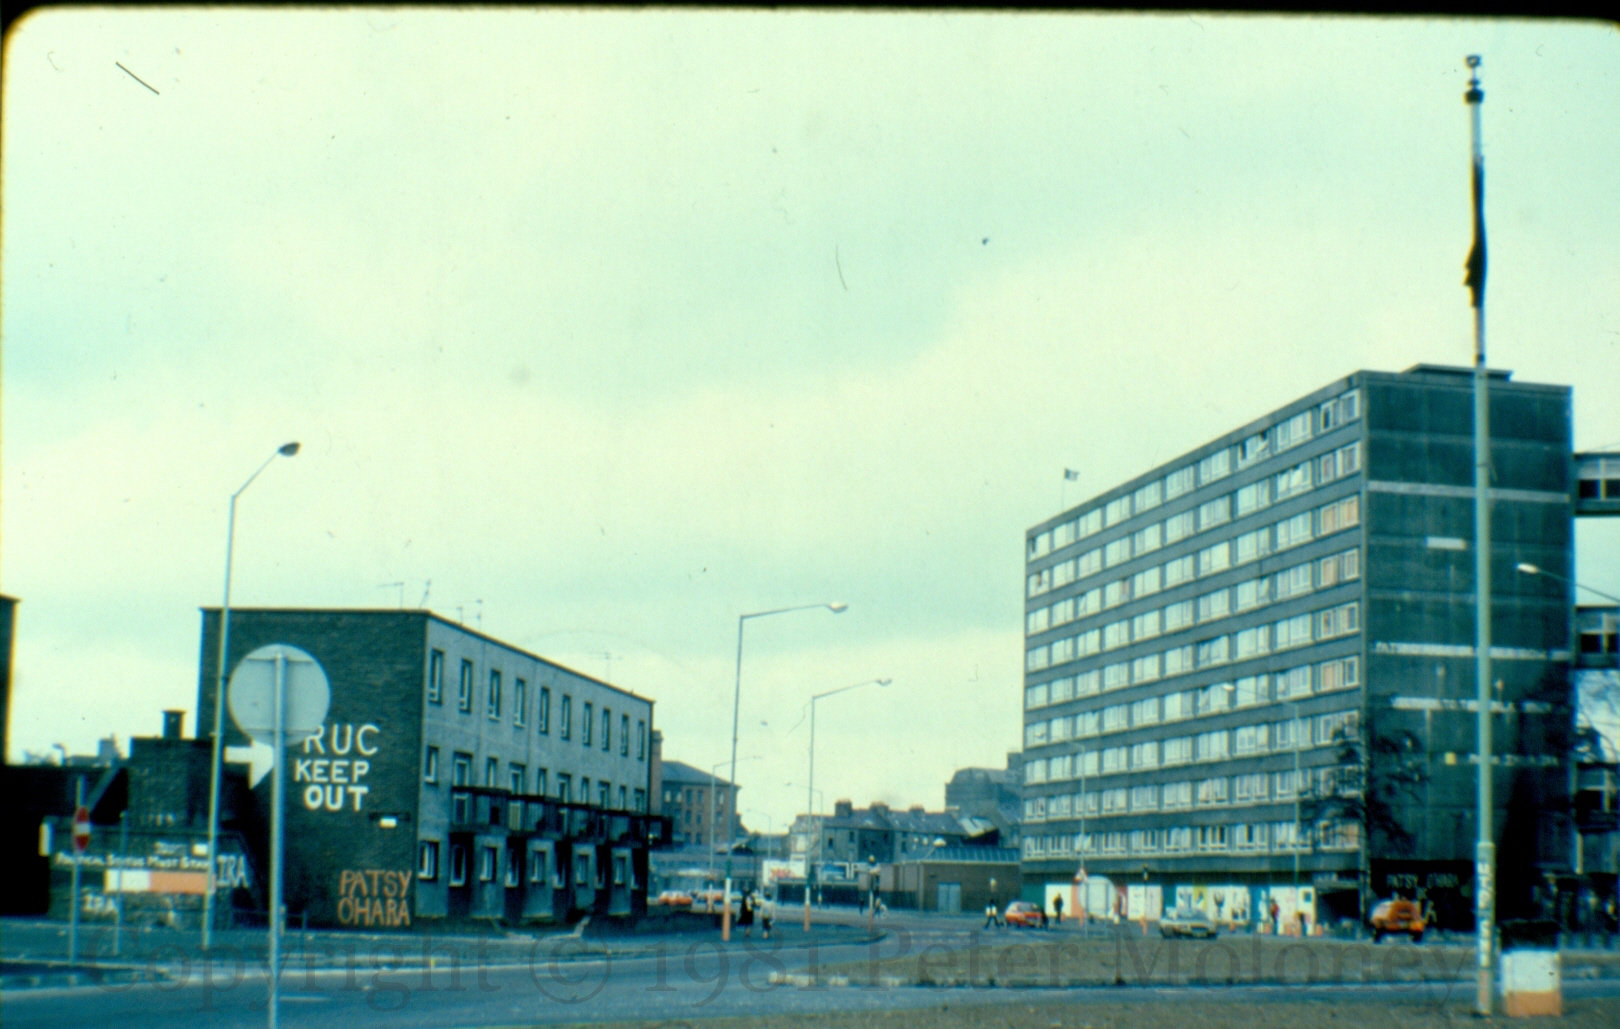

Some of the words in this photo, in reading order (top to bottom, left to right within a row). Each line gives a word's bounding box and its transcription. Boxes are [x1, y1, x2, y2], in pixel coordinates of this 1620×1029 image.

[303, 723, 380, 756] RUC
[294, 758, 370, 783] KEEP
[303, 785, 369, 812] OUT
[216, 854, 249, 888] IRA
[339, 868, 412, 898] PATSY
